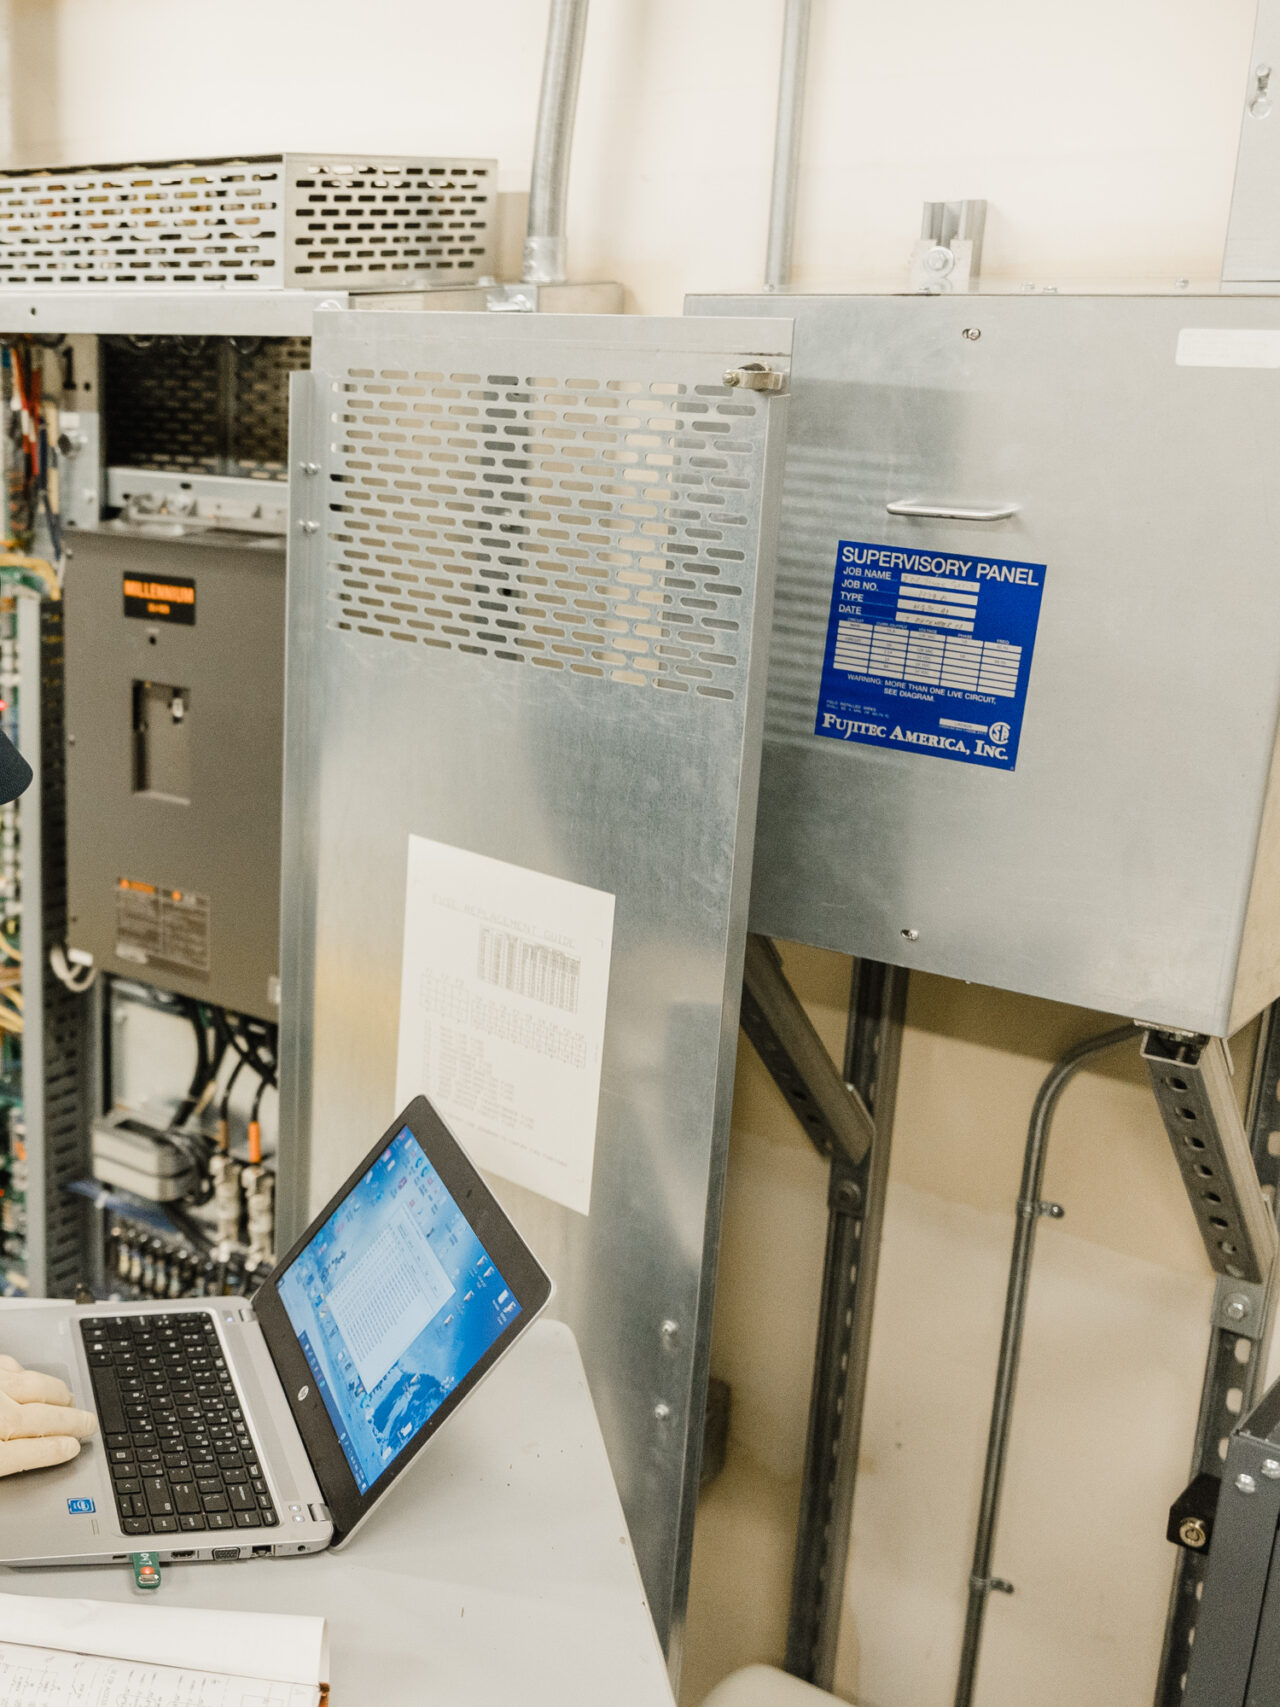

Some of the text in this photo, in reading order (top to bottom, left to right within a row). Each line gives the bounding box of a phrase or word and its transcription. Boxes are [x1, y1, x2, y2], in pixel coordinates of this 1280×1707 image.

[62, 346, 77, 390] 1
[841, 546, 972, 577] SUPERVISORY
[976, 562, 1040, 586] PANEL
[843, 566, 892, 580] JOB NAME
[841, 579, 879, 592] JOB NO.
[840, 591, 864, 603] TYPE
[838, 603, 862, 615] DATE
[847, 673, 882, 686] WARNING:
[884, 679, 907, 690] MORE
[908, 683, 928, 693] THAN
[929, 686, 946, 696] ONE
[946, 689, 963, 699] LIVE
[883, 687, 898, 696] SEE
[973, 739, 1009, 760] INC.
[464, 903, 536, 936] REPLACEMENT
